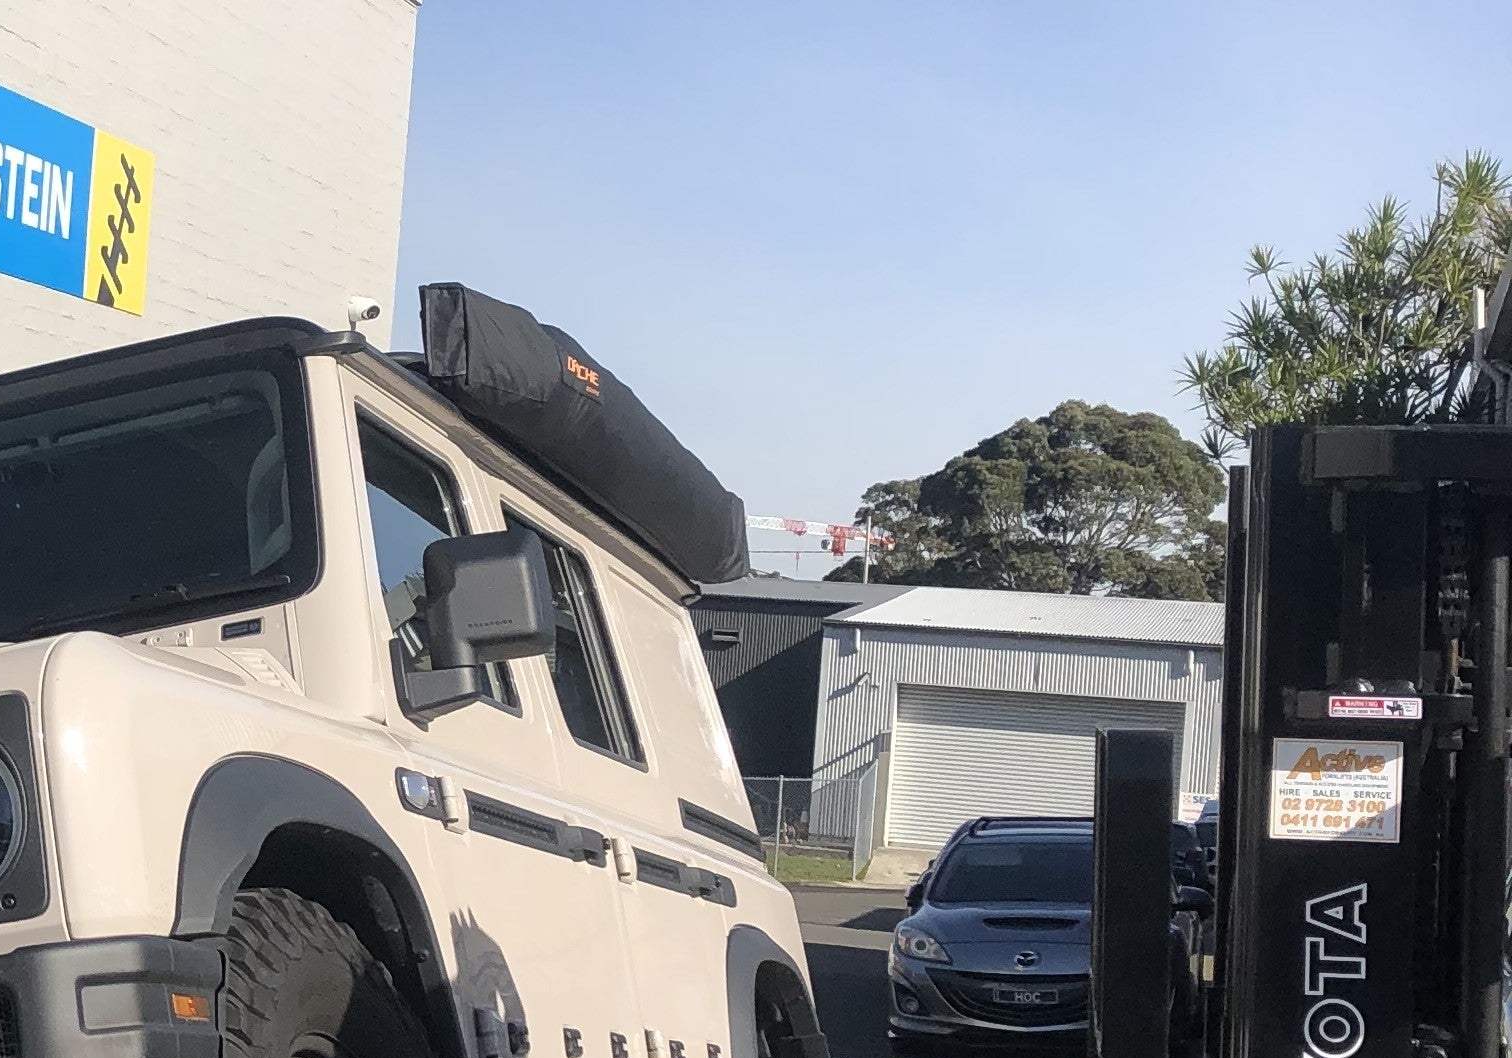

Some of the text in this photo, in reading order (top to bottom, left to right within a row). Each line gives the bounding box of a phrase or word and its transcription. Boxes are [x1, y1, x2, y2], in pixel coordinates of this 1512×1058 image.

[1285, 746, 1386, 781] Active
[1279, 788, 1392, 799] HIRE SALES SERVICE
[1281, 797, 1302, 811] 02
[1347, 800, 1386, 813] 3100
[1280, 813, 1319, 827] 0411
